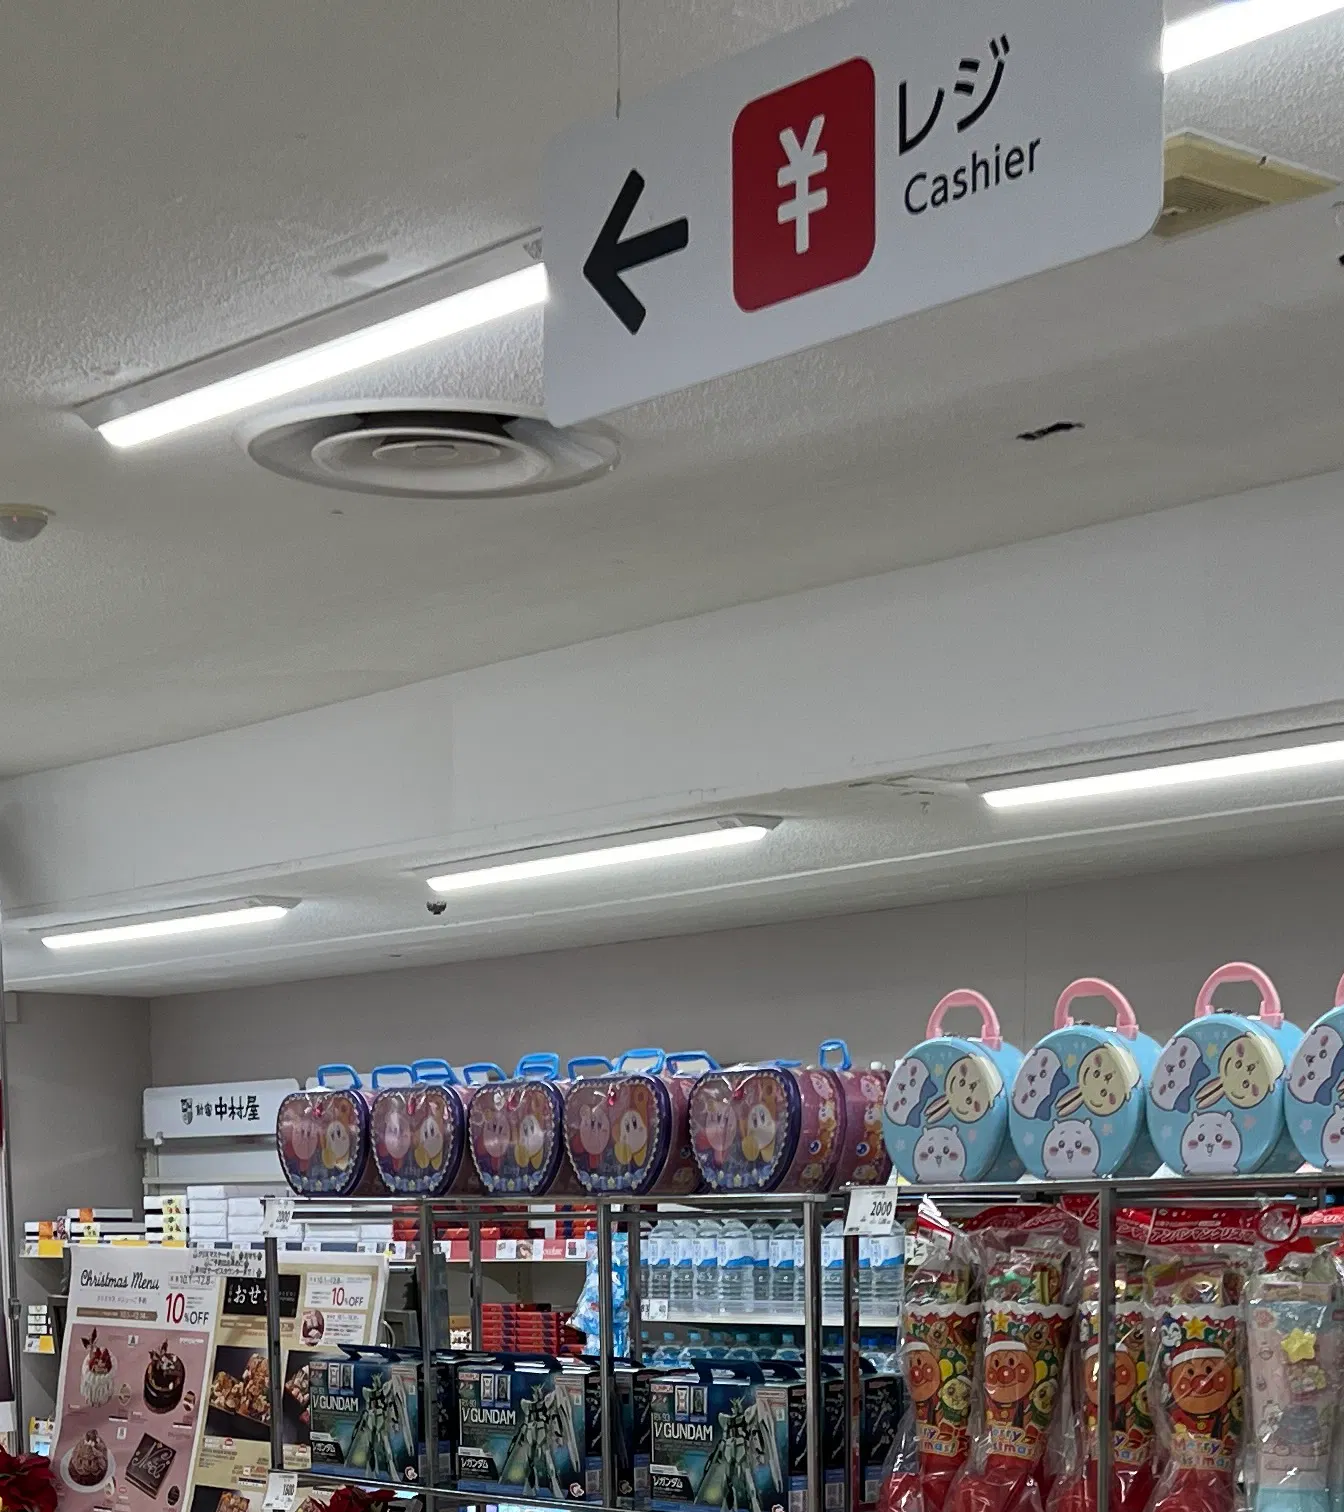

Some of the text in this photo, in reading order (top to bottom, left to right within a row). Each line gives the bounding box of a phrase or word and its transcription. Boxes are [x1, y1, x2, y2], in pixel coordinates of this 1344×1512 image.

[898, 34, 1010, 156] レジ
[903, 137, 1041, 216] Cashier
[869, 1201, 892, 1217] 2000
[80, 1269, 160, 1290] Christmas Menu
[319, 1396, 359, 1412] GUNDAM
[470, 1408, 516, 1426] GUNDAM
[663, 1423, 713, 1442] GUNDAM
